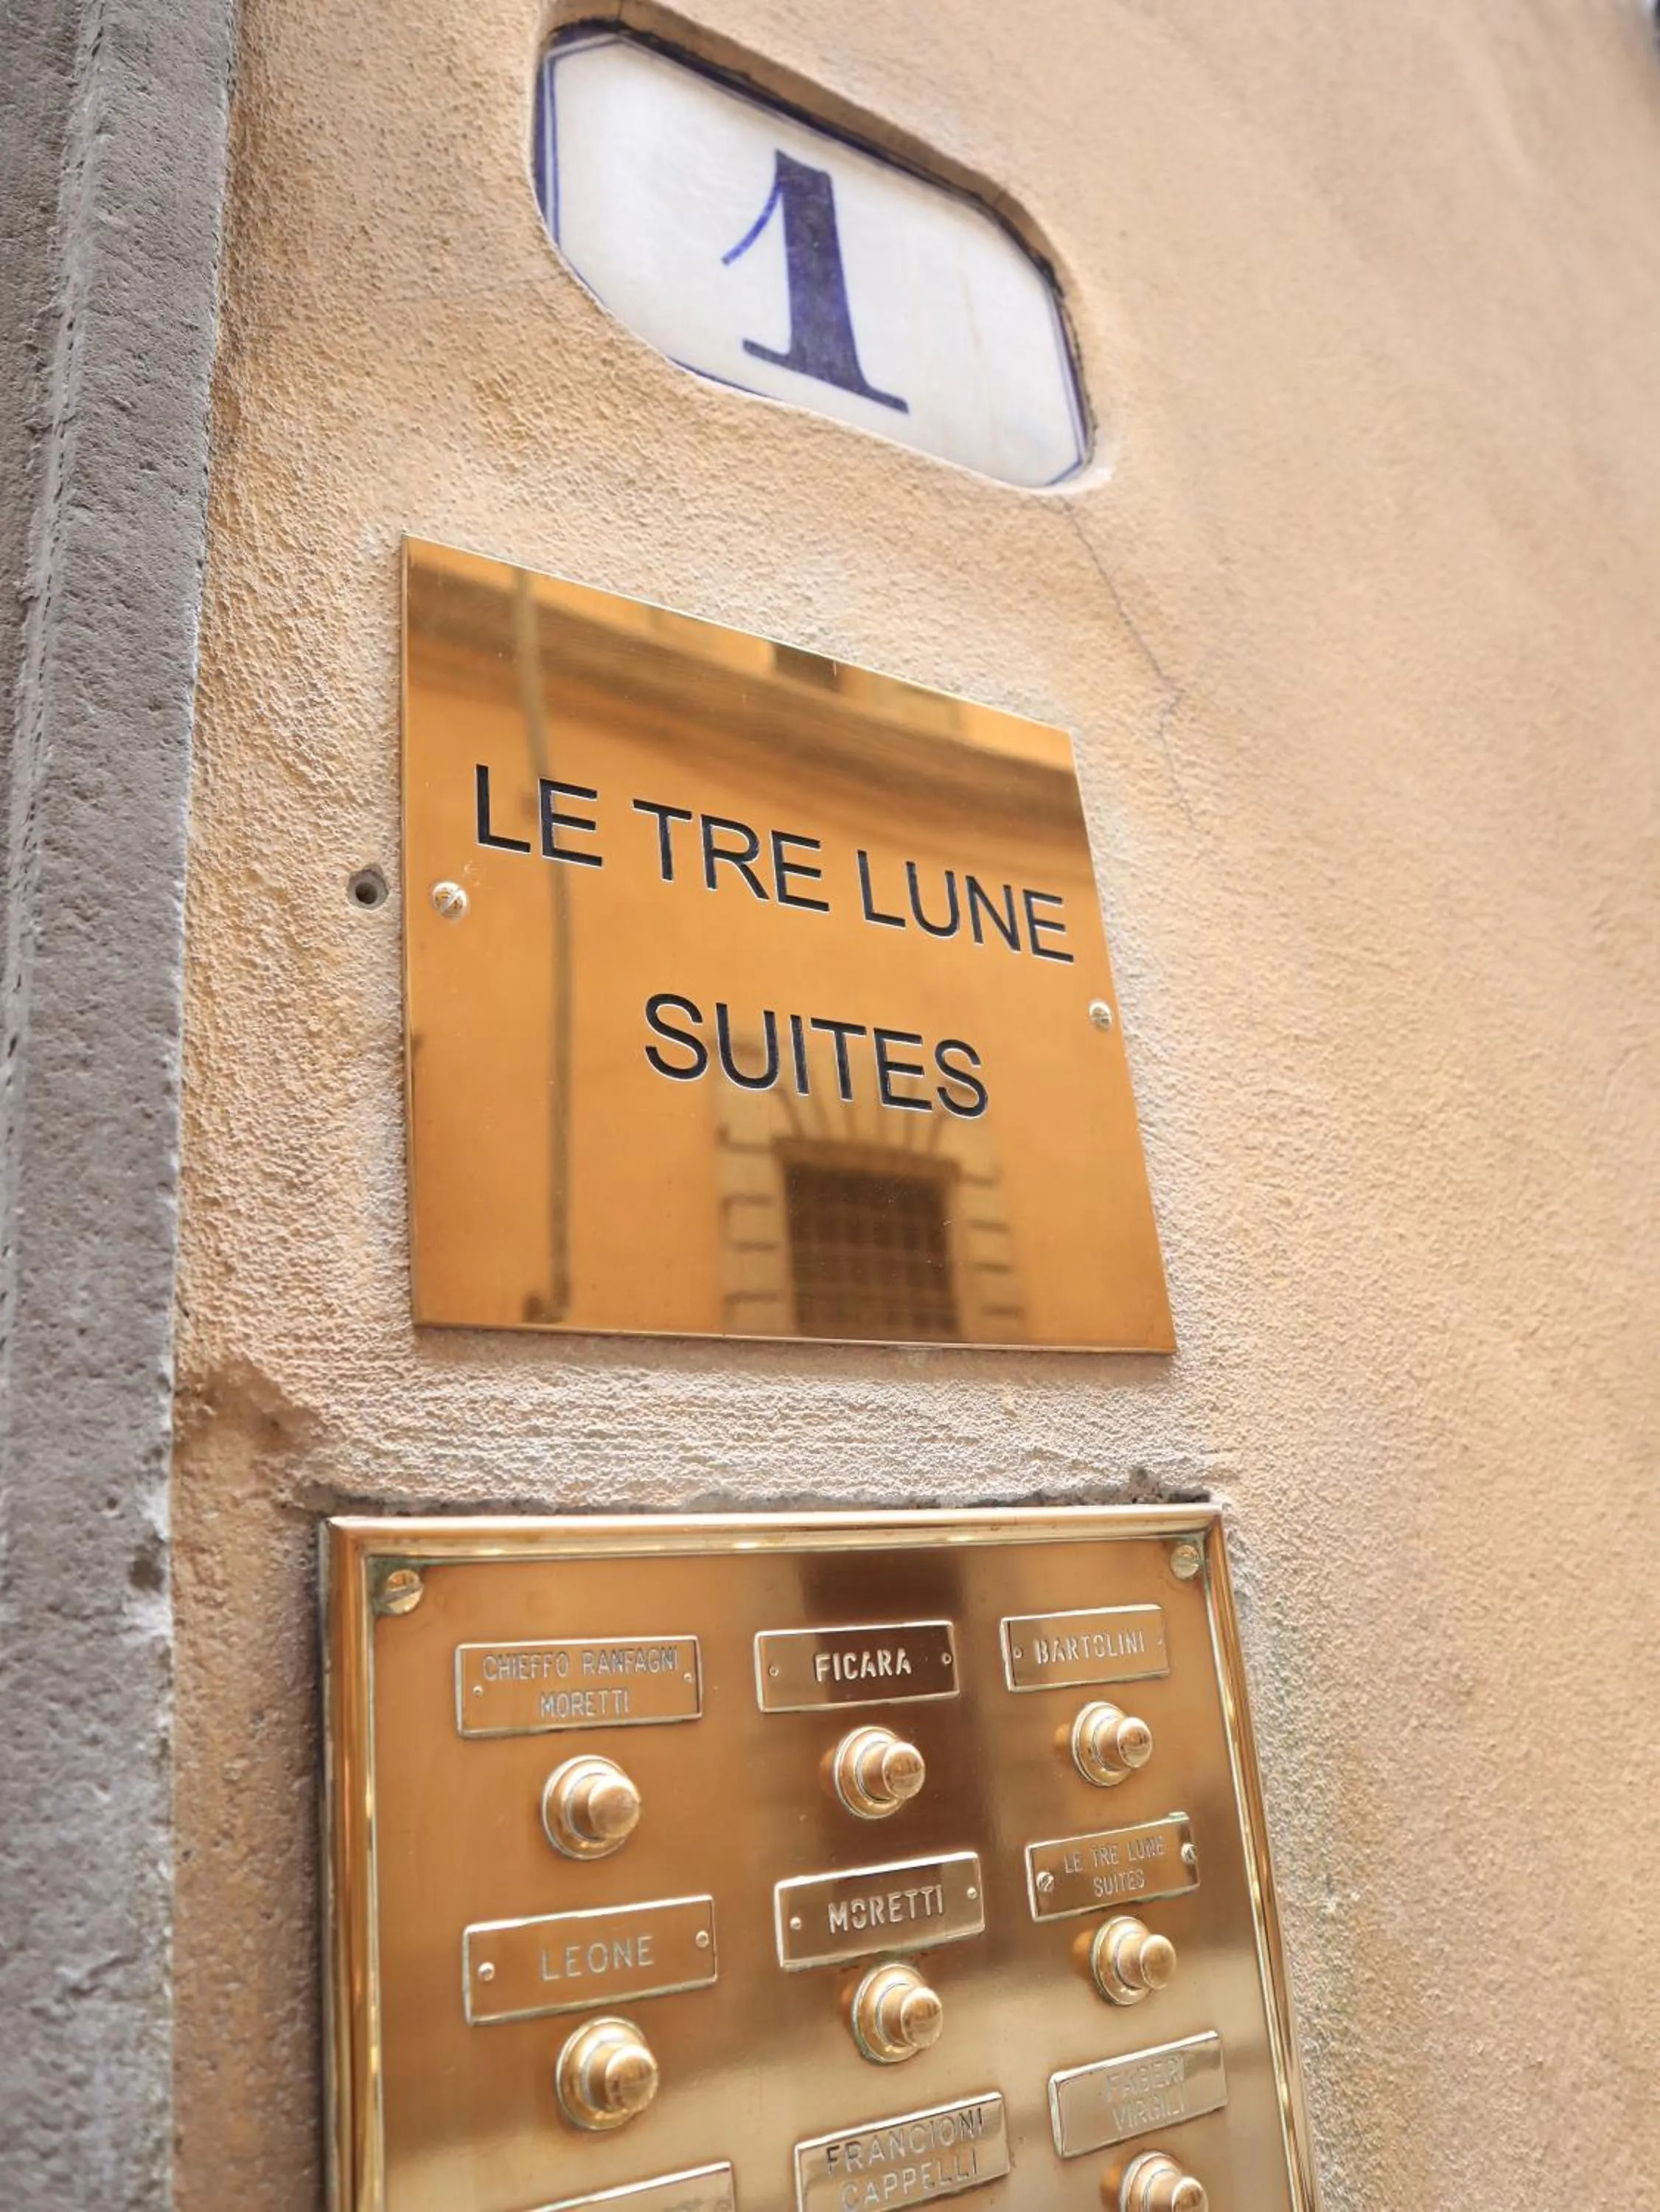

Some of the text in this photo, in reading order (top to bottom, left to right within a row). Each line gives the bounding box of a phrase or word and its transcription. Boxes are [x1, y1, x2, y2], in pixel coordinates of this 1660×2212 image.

[721, 148, 909, 414] 1
[475, 763, 1074, 964] LE TRE LUNE
[644, 993, 988, 1119] SUITES
[483, 1646, 679, 1681] CHIEFFO RANFAGNI
[815, 1648, 912, 1683] FICARA
[1034, 1631, 1145, 1665] BARTOLINI
[540, 1689, 630, 1718] MORETTI
[1064, 1835, 1165, 1874] LE TRE LUNE
[1093, 1869, 1145, 1897] SUITES
[828, 1885, 944, 1933] MORETTI
[541, 1935, 655, 1981] LEONE
[826, 2107, 985, 2175] FRANCIONI
[841, 2146, 978, 2212] CAPPELLI
